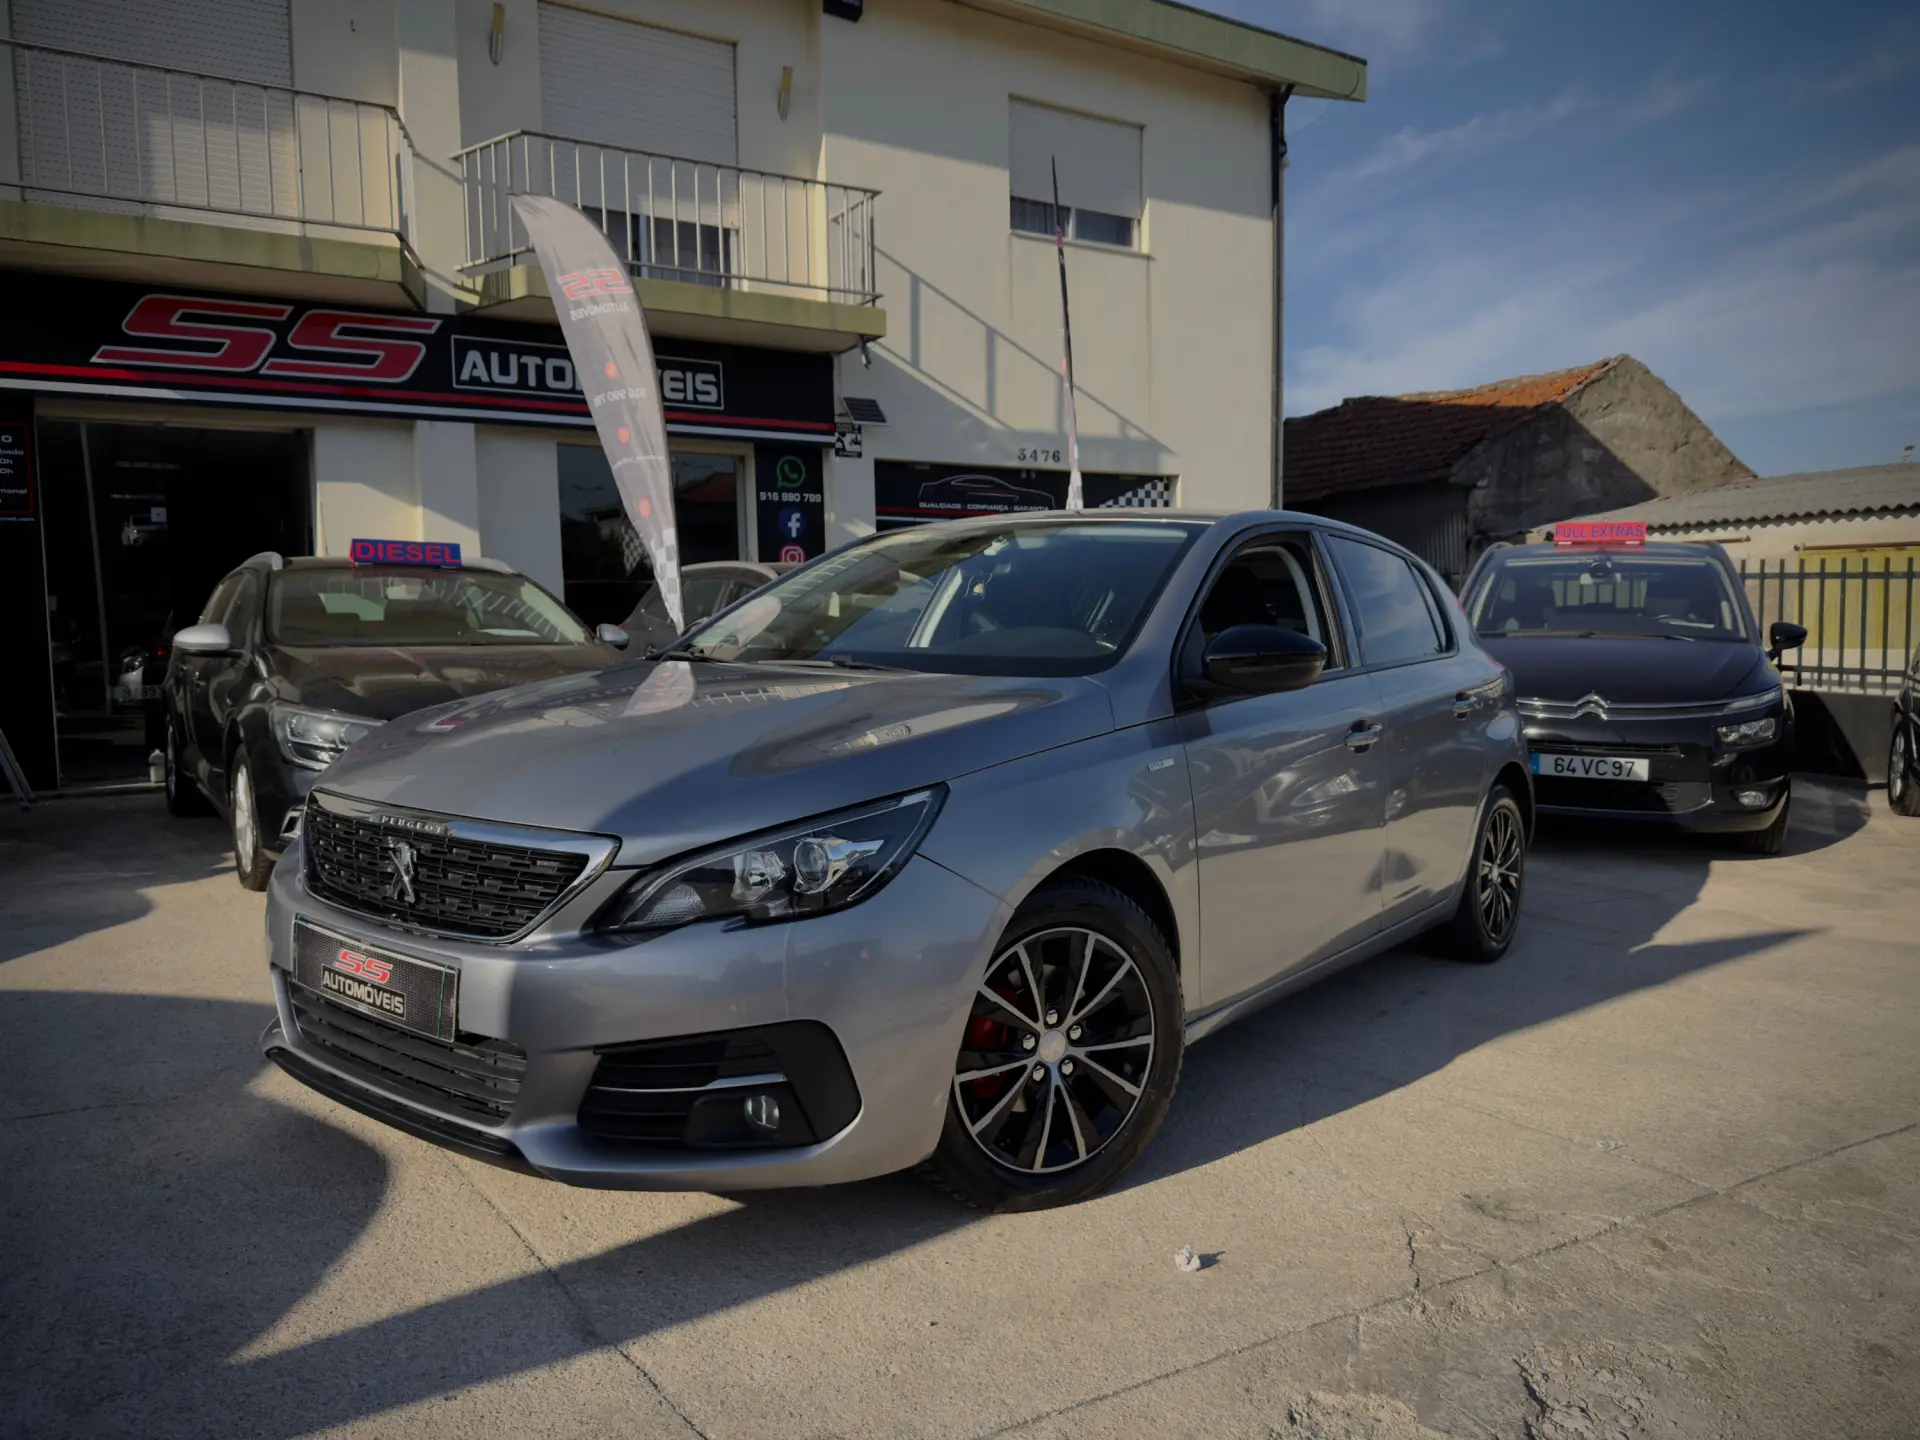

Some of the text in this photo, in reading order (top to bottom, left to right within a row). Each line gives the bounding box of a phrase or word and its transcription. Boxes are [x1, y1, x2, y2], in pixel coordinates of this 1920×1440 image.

[90, 293, 443, 383] SS
[459, 349, 719, 404] AUTOEIS
[1018, 447, 1061, 463] 3476
[967, 503, 1009, 512] CONFIANÇA
[1555, 524, 1645, 539] FULL EXTRAS
[355, 542, 461, 564] DIESEL
[1554, 757, 1635, 778] 64 VC 97
[381, 815, 443, 834] PEUGEOT
[334, 949, 394, 984] SS
[322, 970, 405, 1015] AUTOMÓVEIS
